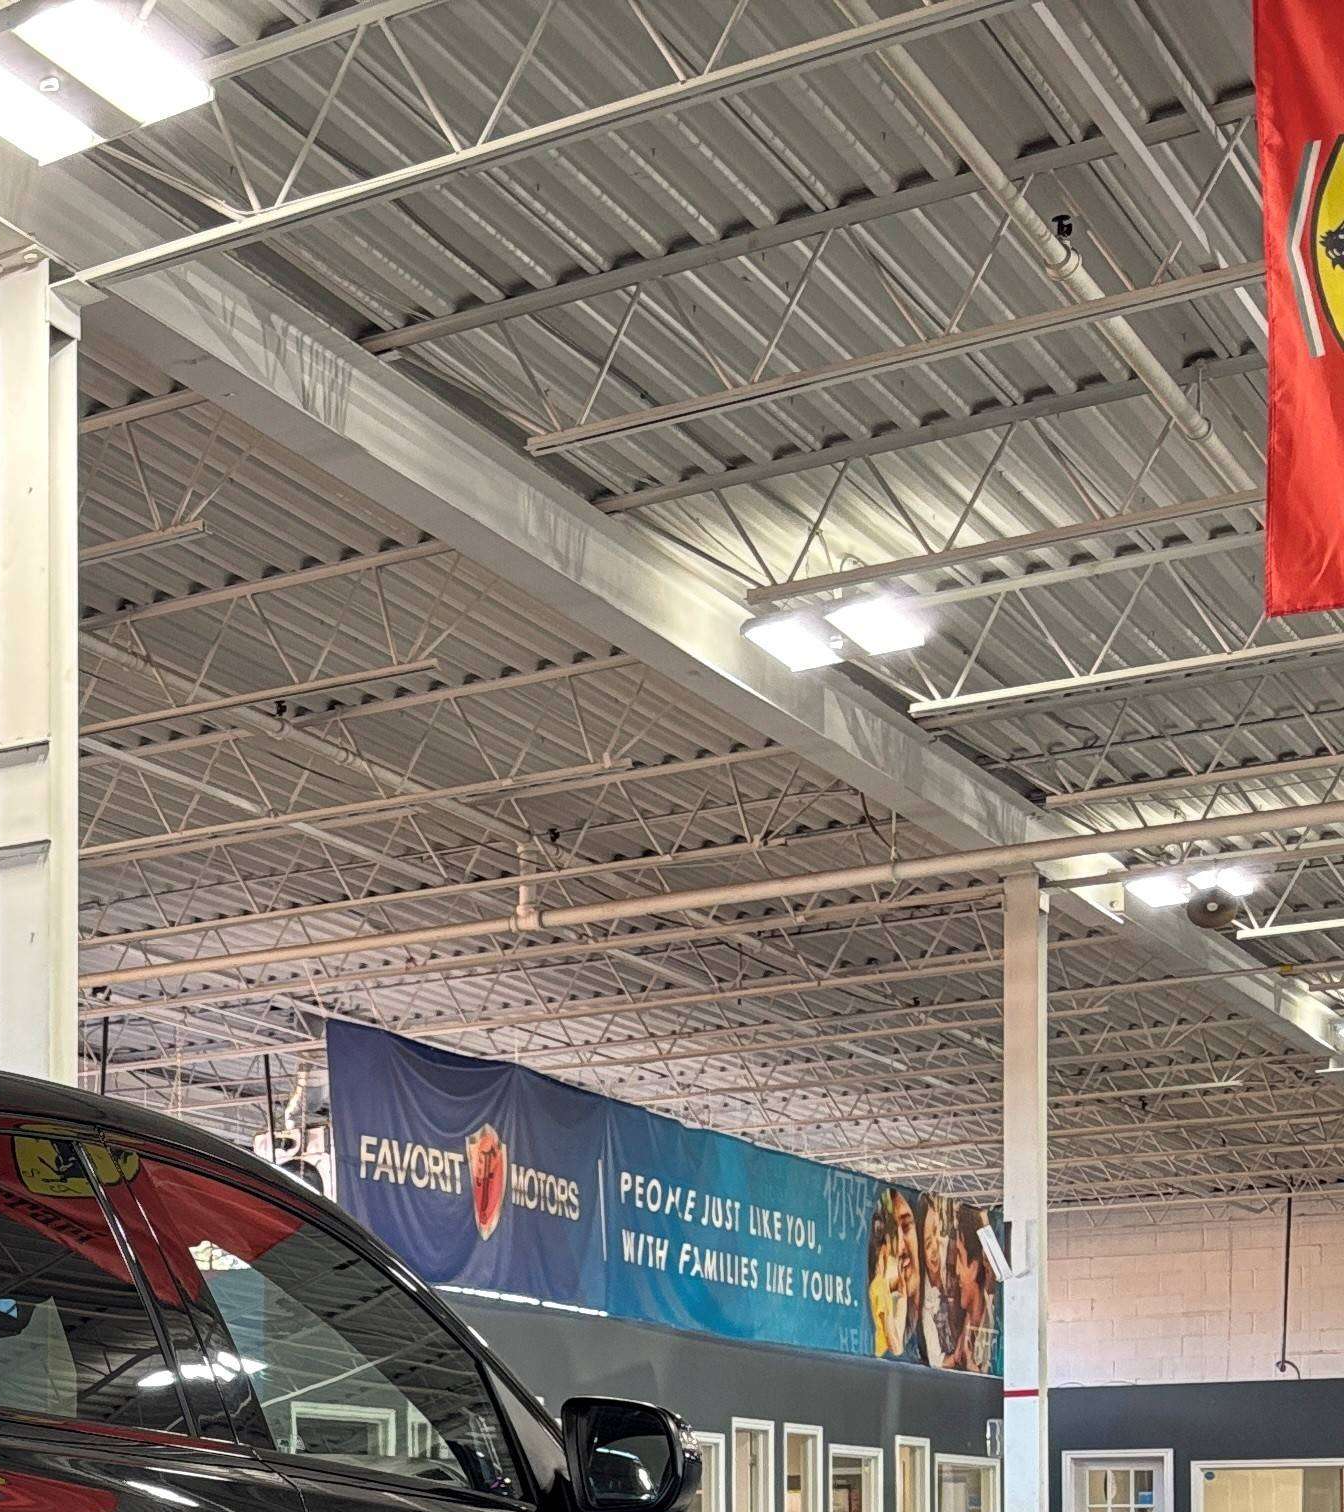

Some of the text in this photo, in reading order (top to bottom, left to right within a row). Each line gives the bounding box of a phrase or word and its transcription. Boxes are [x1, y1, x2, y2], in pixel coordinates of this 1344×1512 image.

[359, 1134, 580, 1221] FAVORIT MOTORS
[701, 1194, 742, 1232] JUST
[749, 1204, 782, 1242] LIKE
[786, 1213, 822, 1255] YOU,
[621, 1228, 859, 1308] WITH FAMILIES LIKE YOURS.
